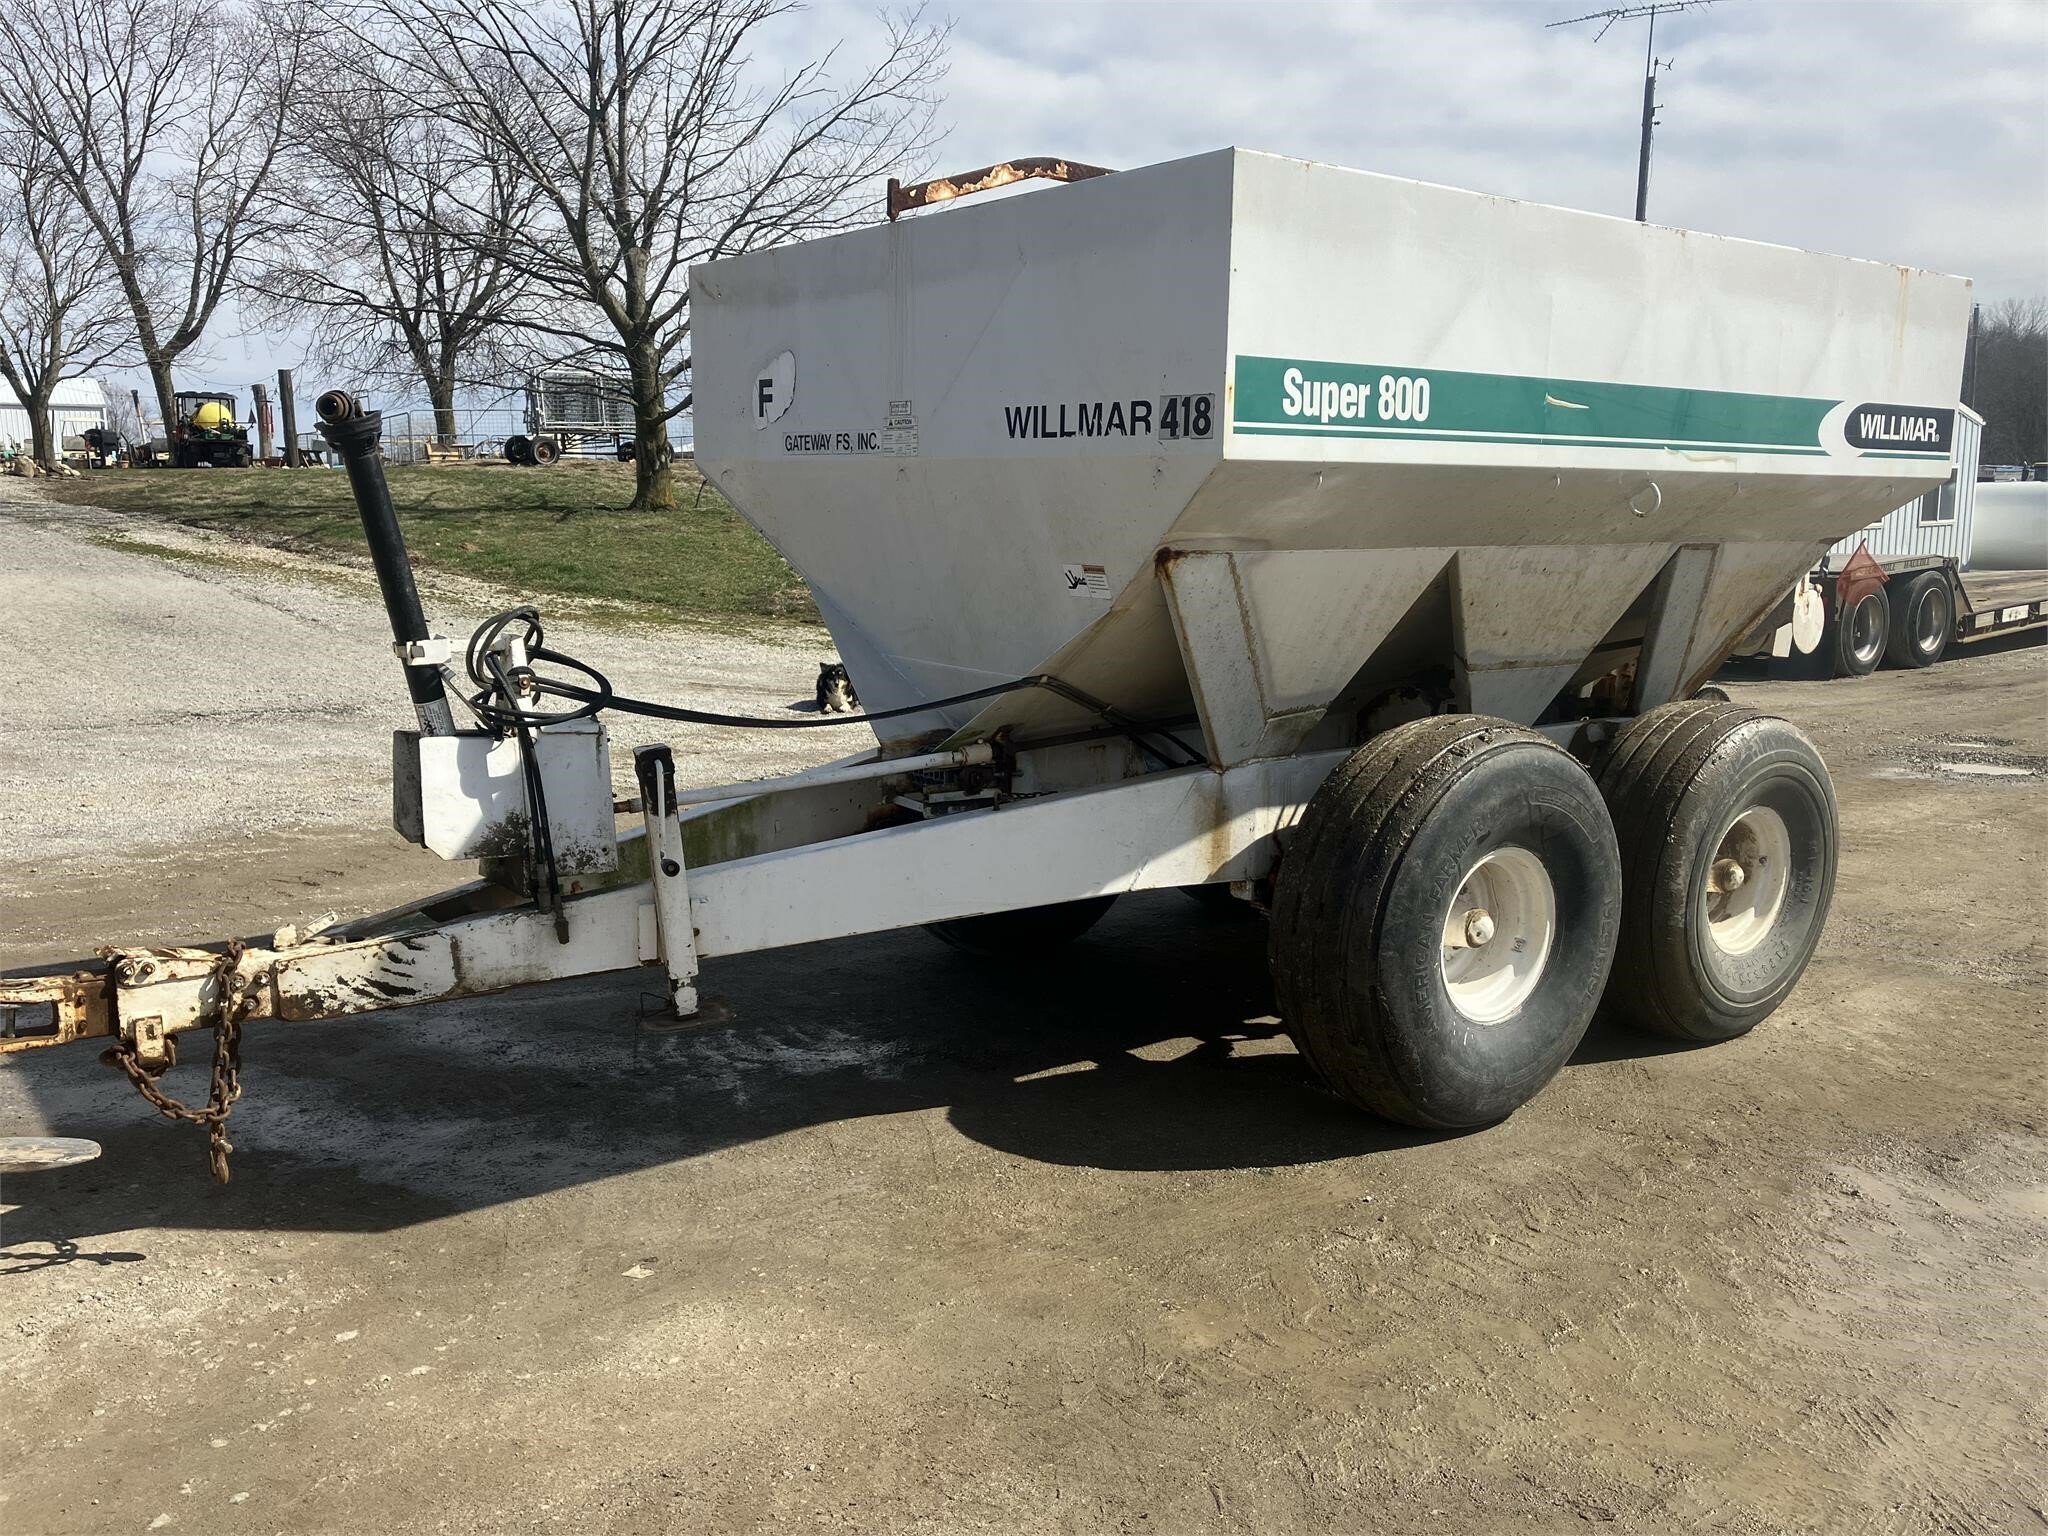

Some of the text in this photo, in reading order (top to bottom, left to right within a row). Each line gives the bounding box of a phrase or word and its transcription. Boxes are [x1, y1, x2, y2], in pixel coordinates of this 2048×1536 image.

[758, 378, 773, 418] F
[1282, 367, 1430, 424] Super 800
[894, 418, 913, 426] CAUTION
[1004, 396, 1211, 439] WILLMAR 418
[1860, 413, 1937, 442] WILLMAR
[784, 434, 831, 452] GATEWAY
[836, 433, 853, 453] FS,
[857, 432, 880, 450] INC.
